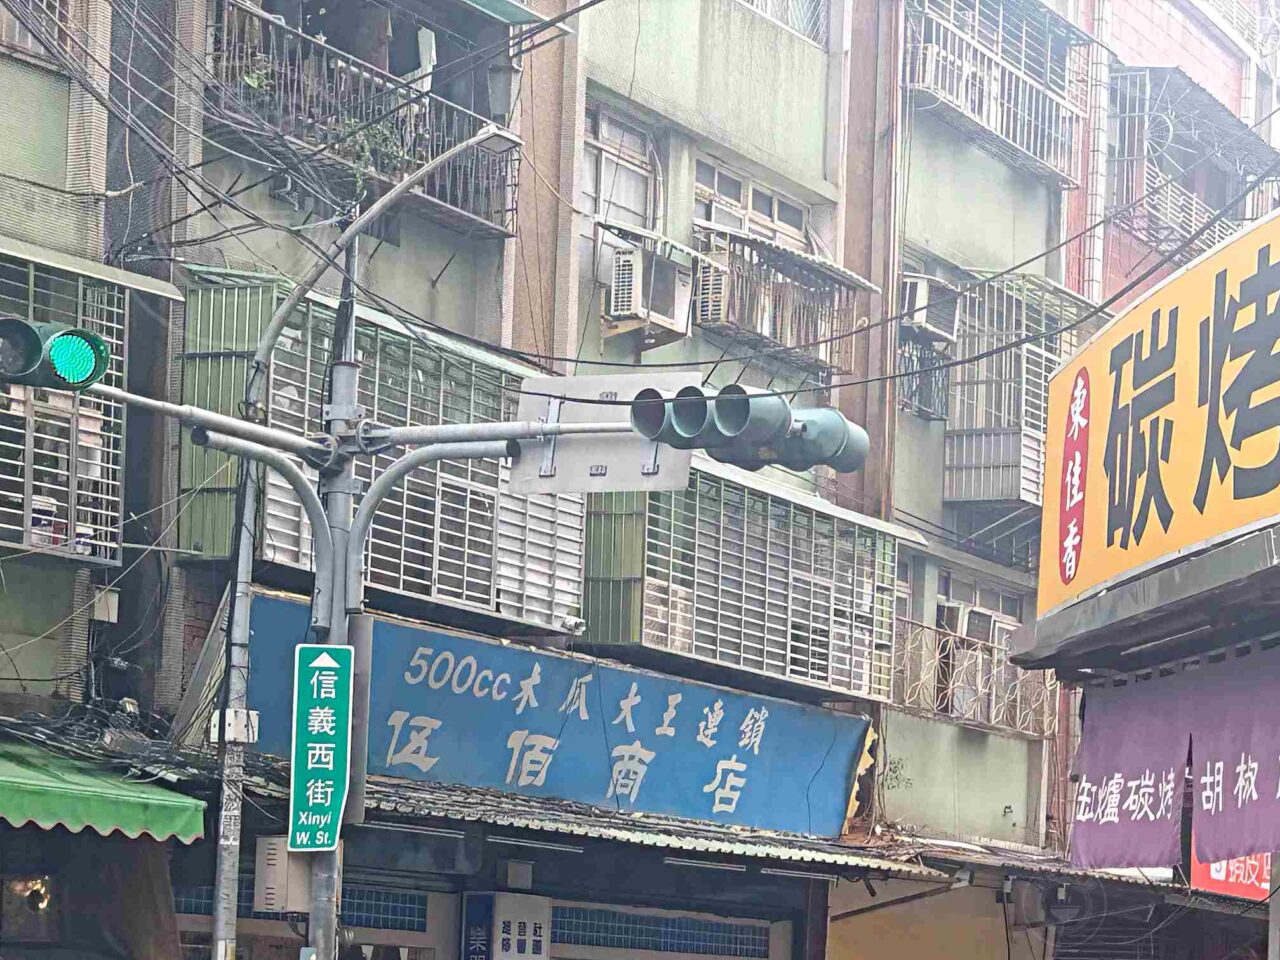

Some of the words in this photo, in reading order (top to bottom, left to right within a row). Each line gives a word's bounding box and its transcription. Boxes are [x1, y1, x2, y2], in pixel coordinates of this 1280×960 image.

[1060, 385, 1088, 579] 東佳香
[306, 670, 337, 808] 信義西街
[296, 832, 312, 845] W.
[316, 830, 331, 844] St.
[298, 810, 331, 828] Xinyi
